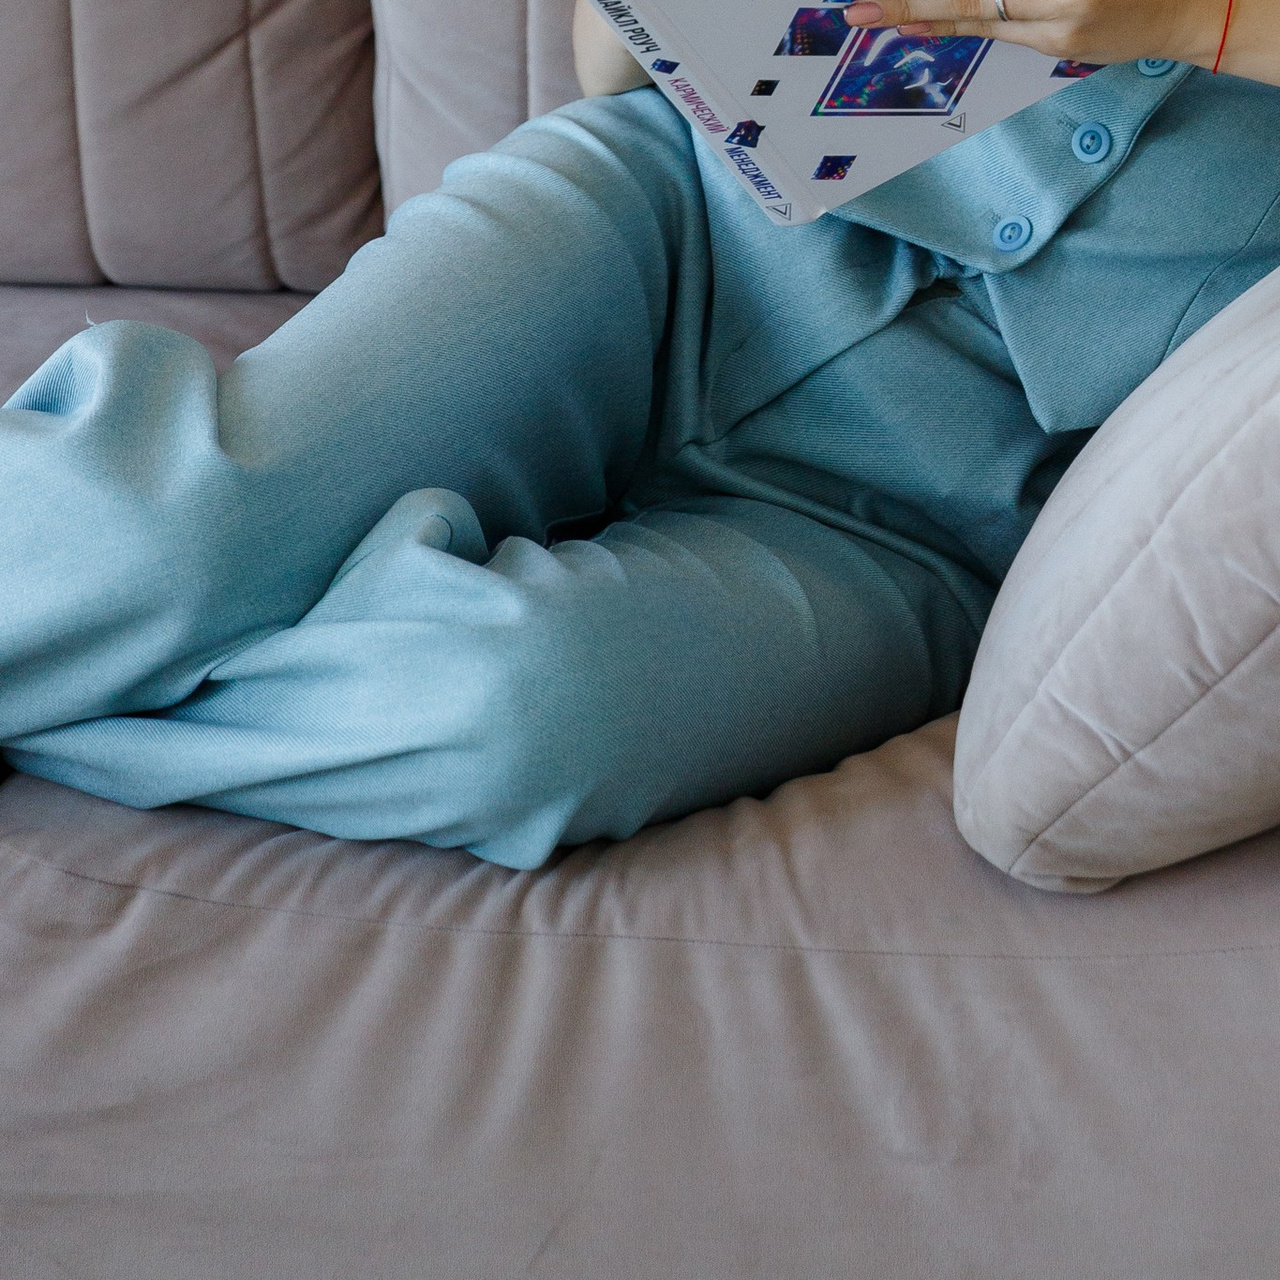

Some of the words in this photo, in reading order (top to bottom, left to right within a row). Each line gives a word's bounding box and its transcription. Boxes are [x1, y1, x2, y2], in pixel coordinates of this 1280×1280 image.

[623, 26, 662, 54] РОУЧ
[667, 77, 731, 134] КАРМИЧЕСКИЙ
[724, 146, 782, 201] МЕНЕДЖМЕНТ
